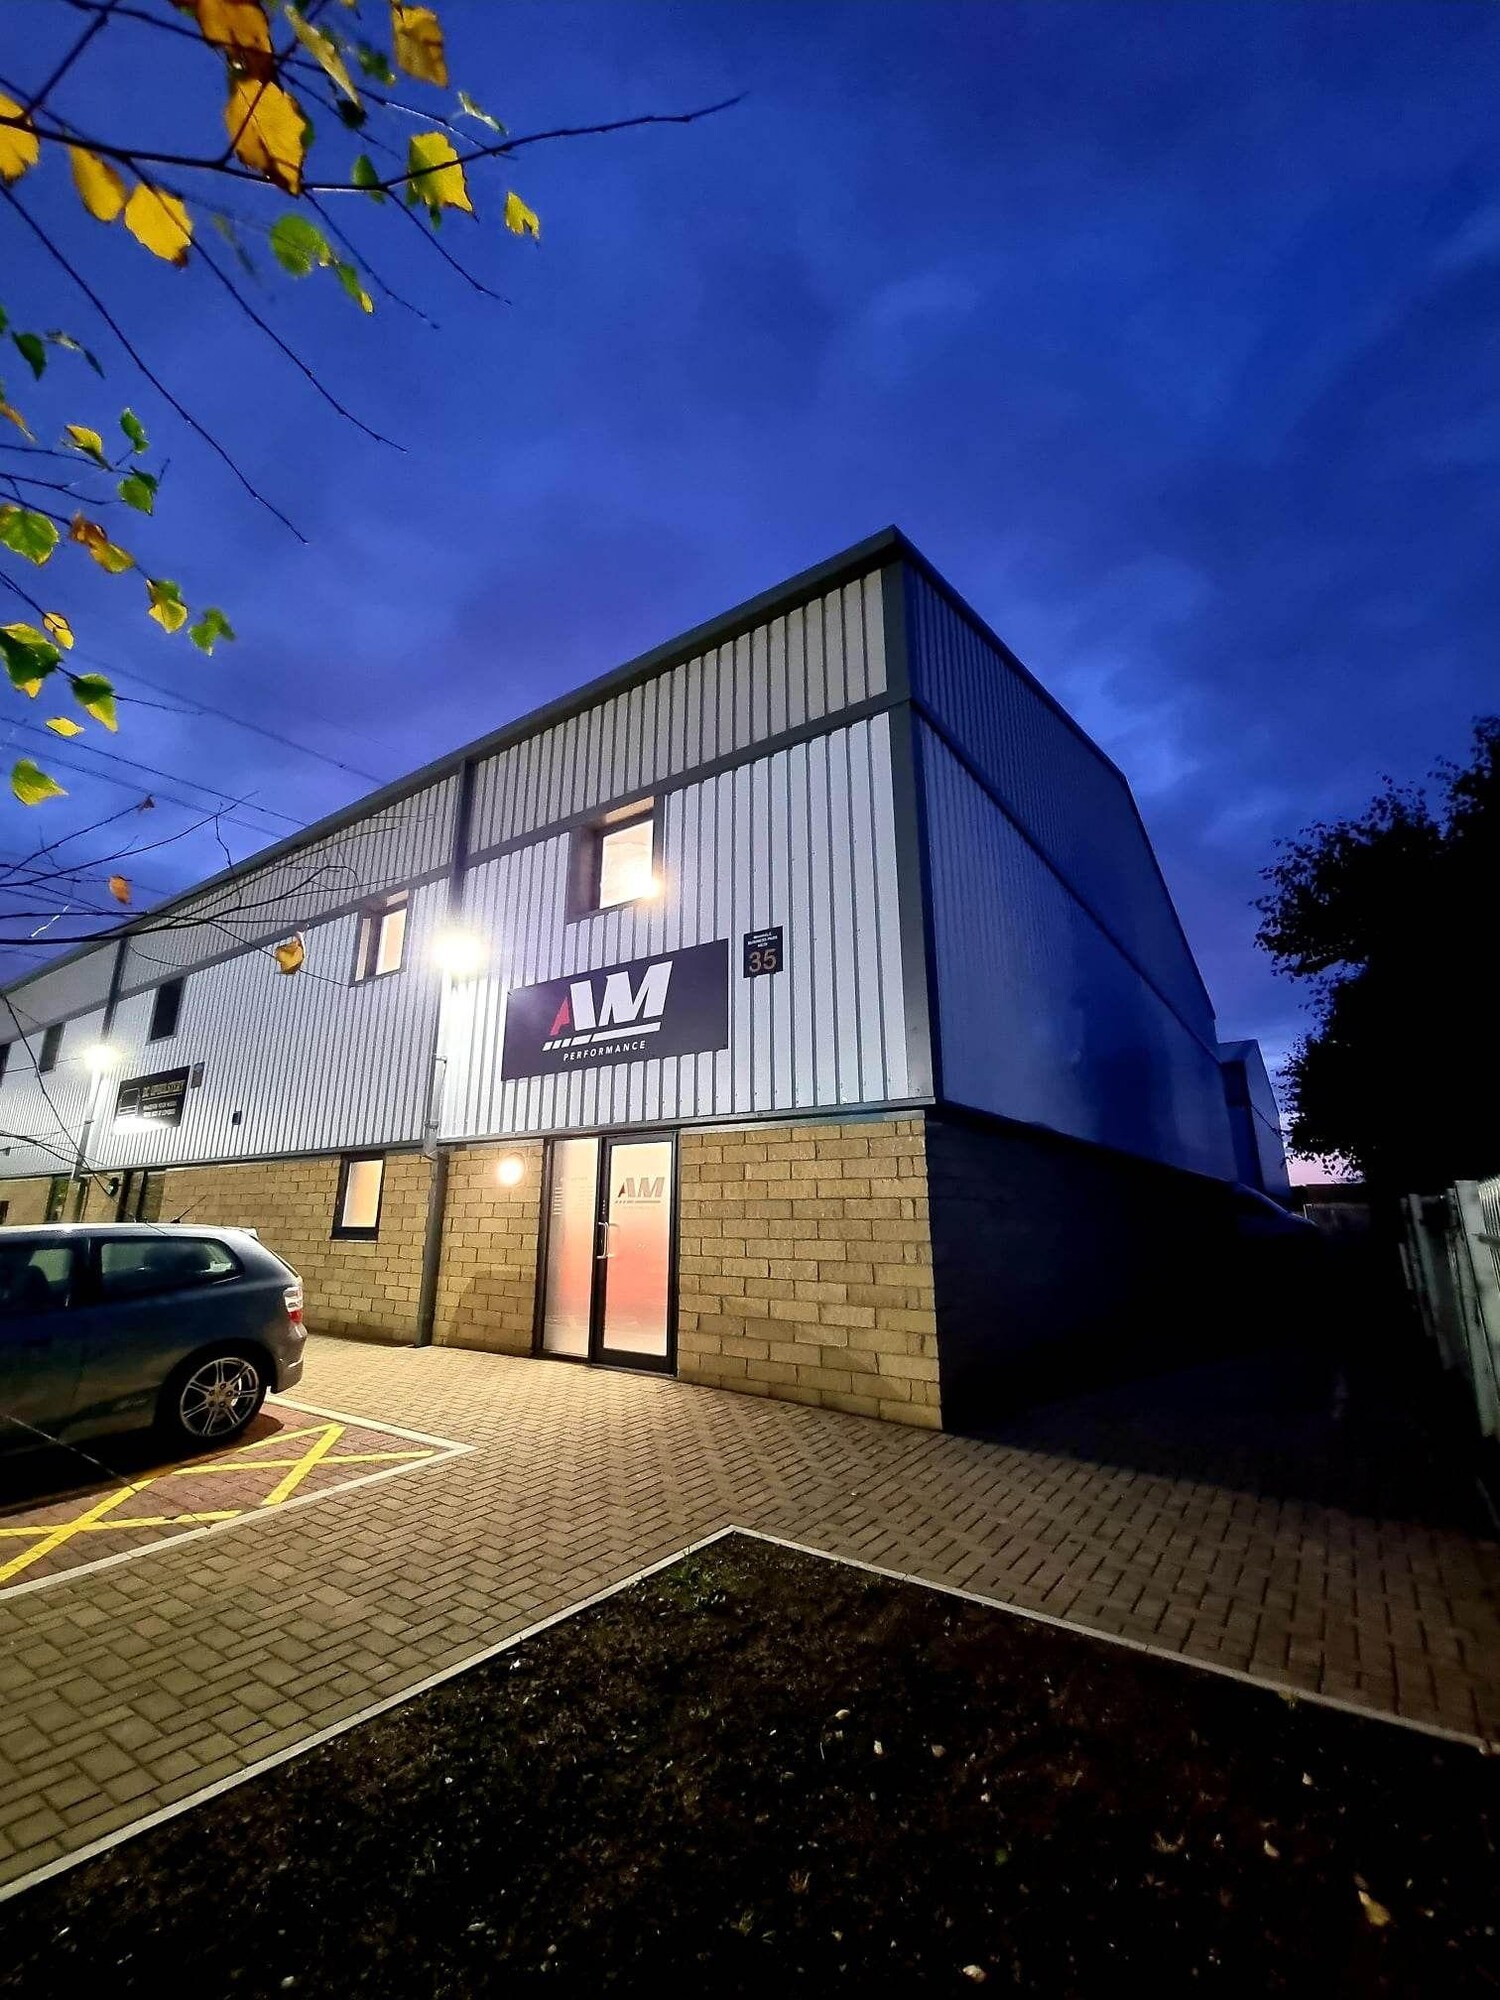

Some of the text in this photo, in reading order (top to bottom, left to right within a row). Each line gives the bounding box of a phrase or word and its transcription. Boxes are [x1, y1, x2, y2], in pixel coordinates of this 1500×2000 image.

[749, 948, 777, 972] 35
[550, 960, 674, 1036] AM
[563, 1040, 647, 1062] PERFORMANCE
[617, 1176, 665, 1198] AM
